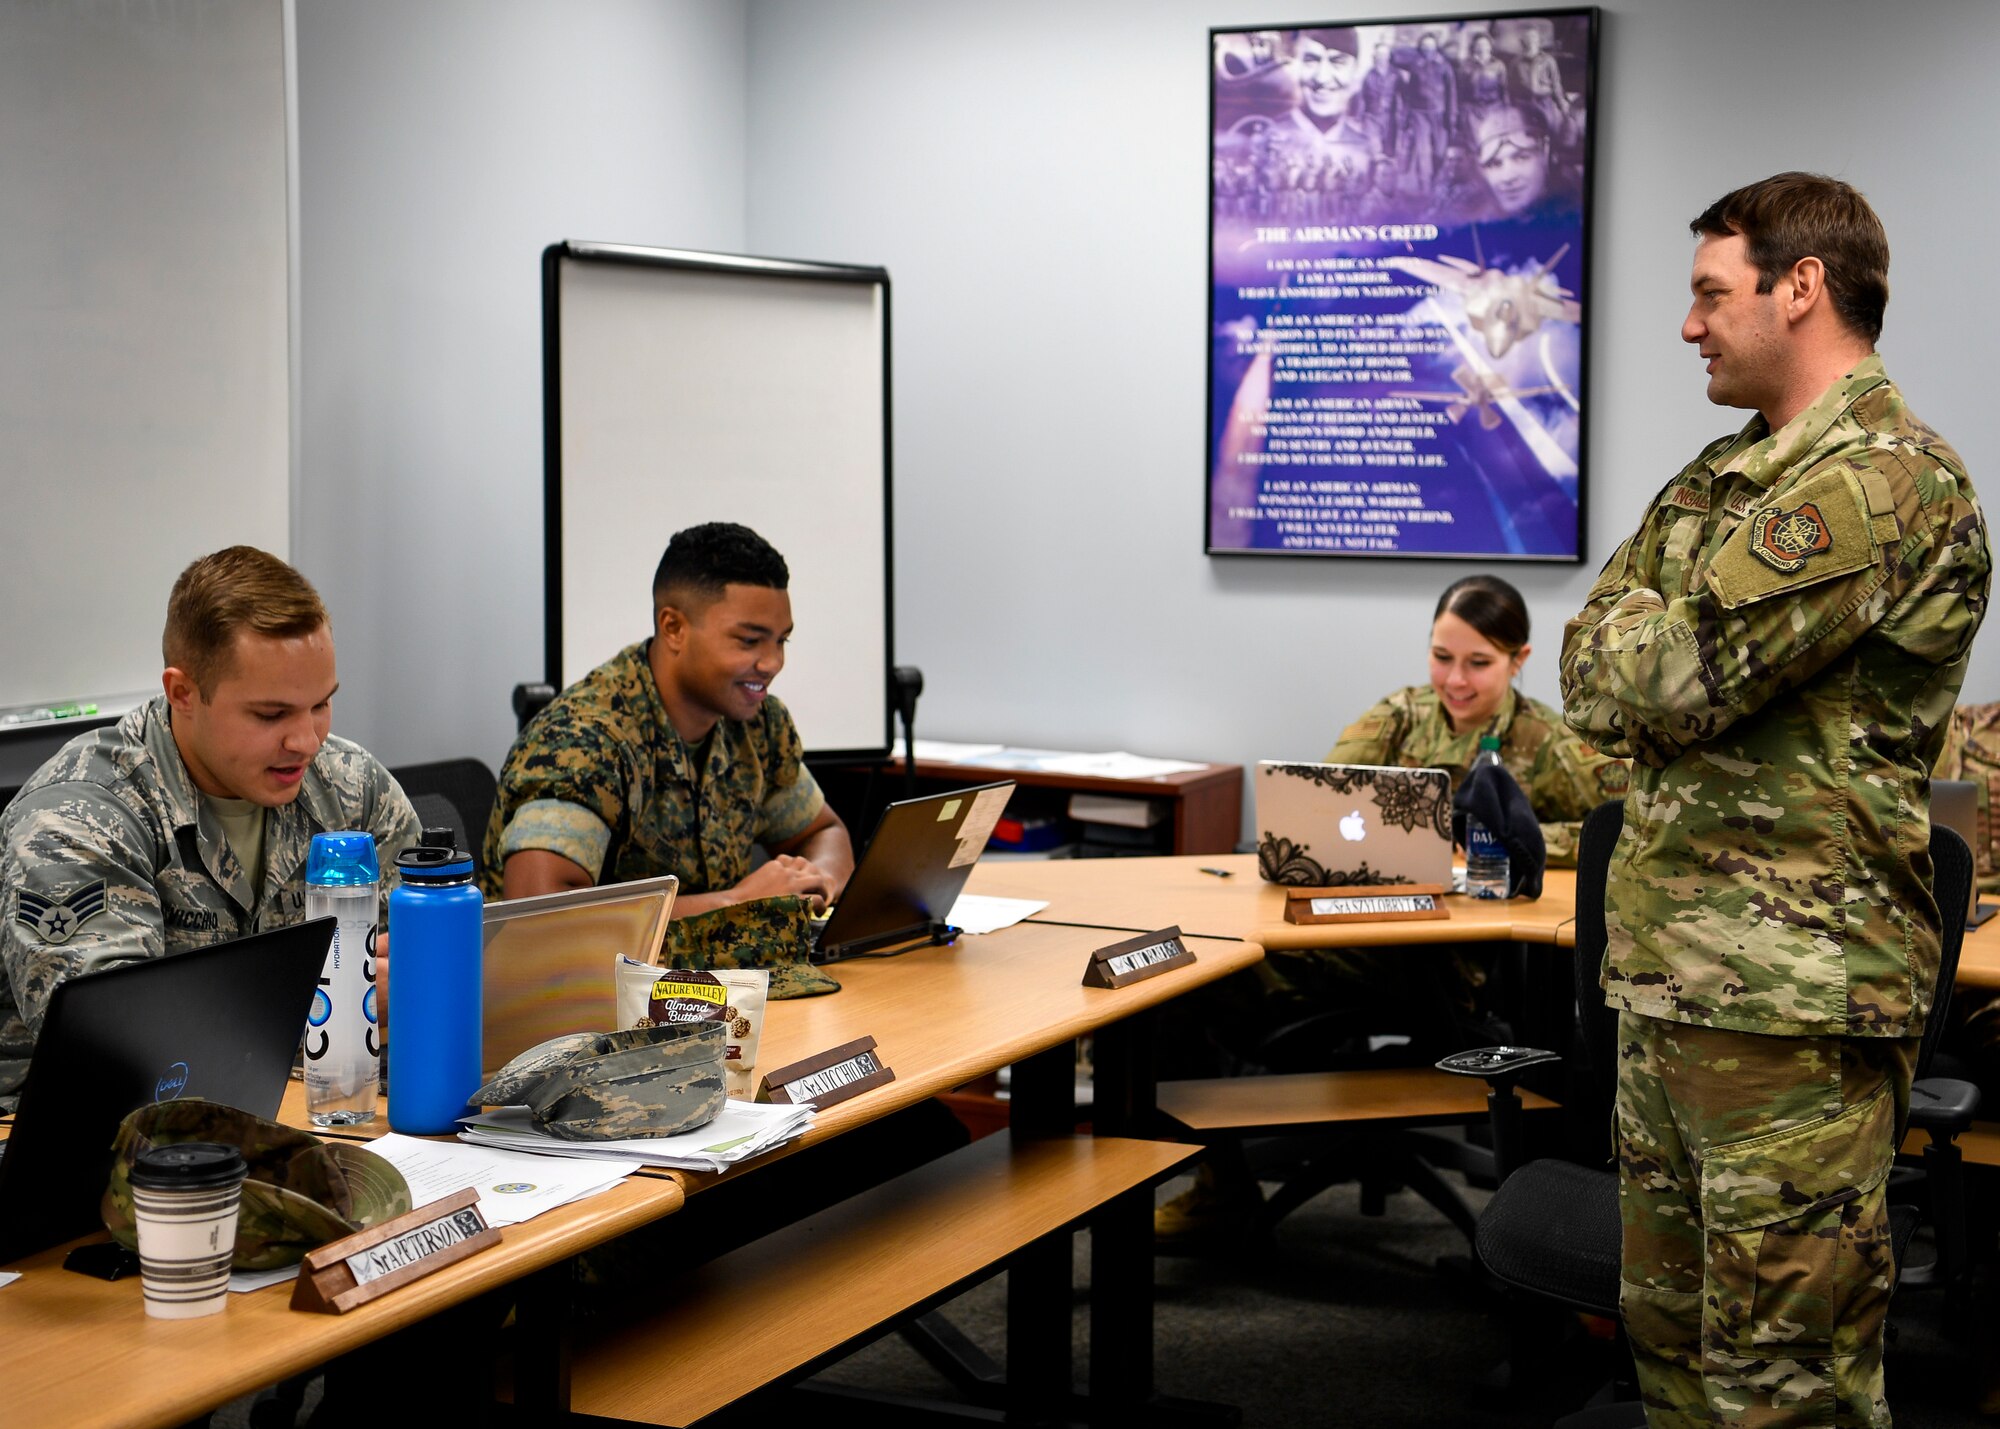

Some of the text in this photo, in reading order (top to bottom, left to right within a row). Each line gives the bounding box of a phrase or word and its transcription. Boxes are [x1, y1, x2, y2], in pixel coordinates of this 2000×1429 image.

[1256, 225, 1439, 242] THE AIRMAN'S CREED
[1760, 549, 1791, 568] COMMAND
[655, 982, 725, 1003] NATURE VALLEY
[664, 999, 711, 1013] Almond
[667, 1010, 704, 1022] Butter
[817, 1061, 862, 1093] VICCHIO
